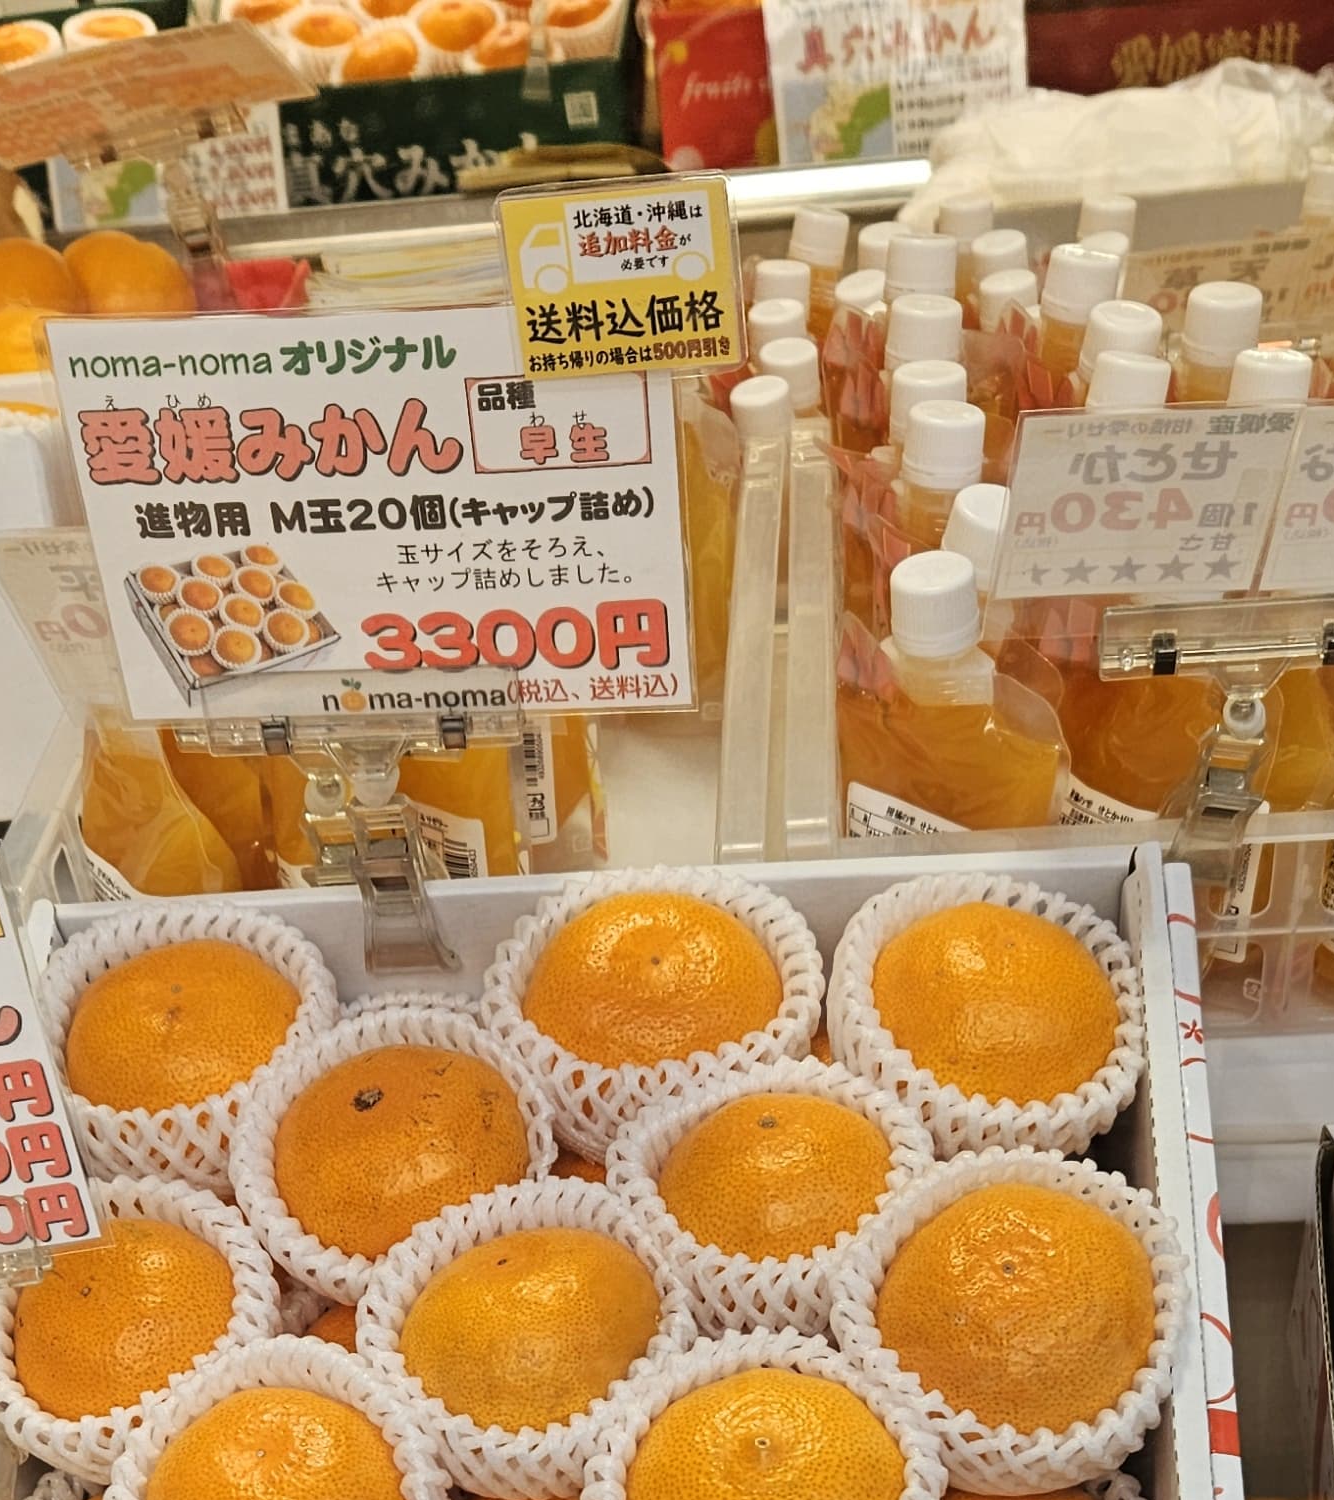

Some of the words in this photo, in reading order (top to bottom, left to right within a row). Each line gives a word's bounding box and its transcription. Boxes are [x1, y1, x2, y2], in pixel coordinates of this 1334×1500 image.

[573, 199, 703, 229] 北海道・沖縄は
[578, 225, 692, 258] 追加料金が
[620, 255, 670, 271] 必要です
[525, 290, 725, 345] 送料込価格
[68, 349, 273, 379] noma-noma
[279, 334, 458, 377] オリジナル
[528, 335, 732, 373] お持ち帰りの場合は500円引き
[476, 381, 537, 413] 品種
[78, 397, 465, 486] 愛媛みかん
[520, 422, 610, 465] 早生
[135, 502, 252, 540] 進物用
[270, 486, 657, 537] M玉20個(キャップ詰め)
[396, 535, 607, 567] 玉サイズをそろえ、
[375, 561, 635, 594] キャップ詰めしました。
[360, 598, 671, 671] 3300円
[505, 675, 680, 706] (税込、送料込)
